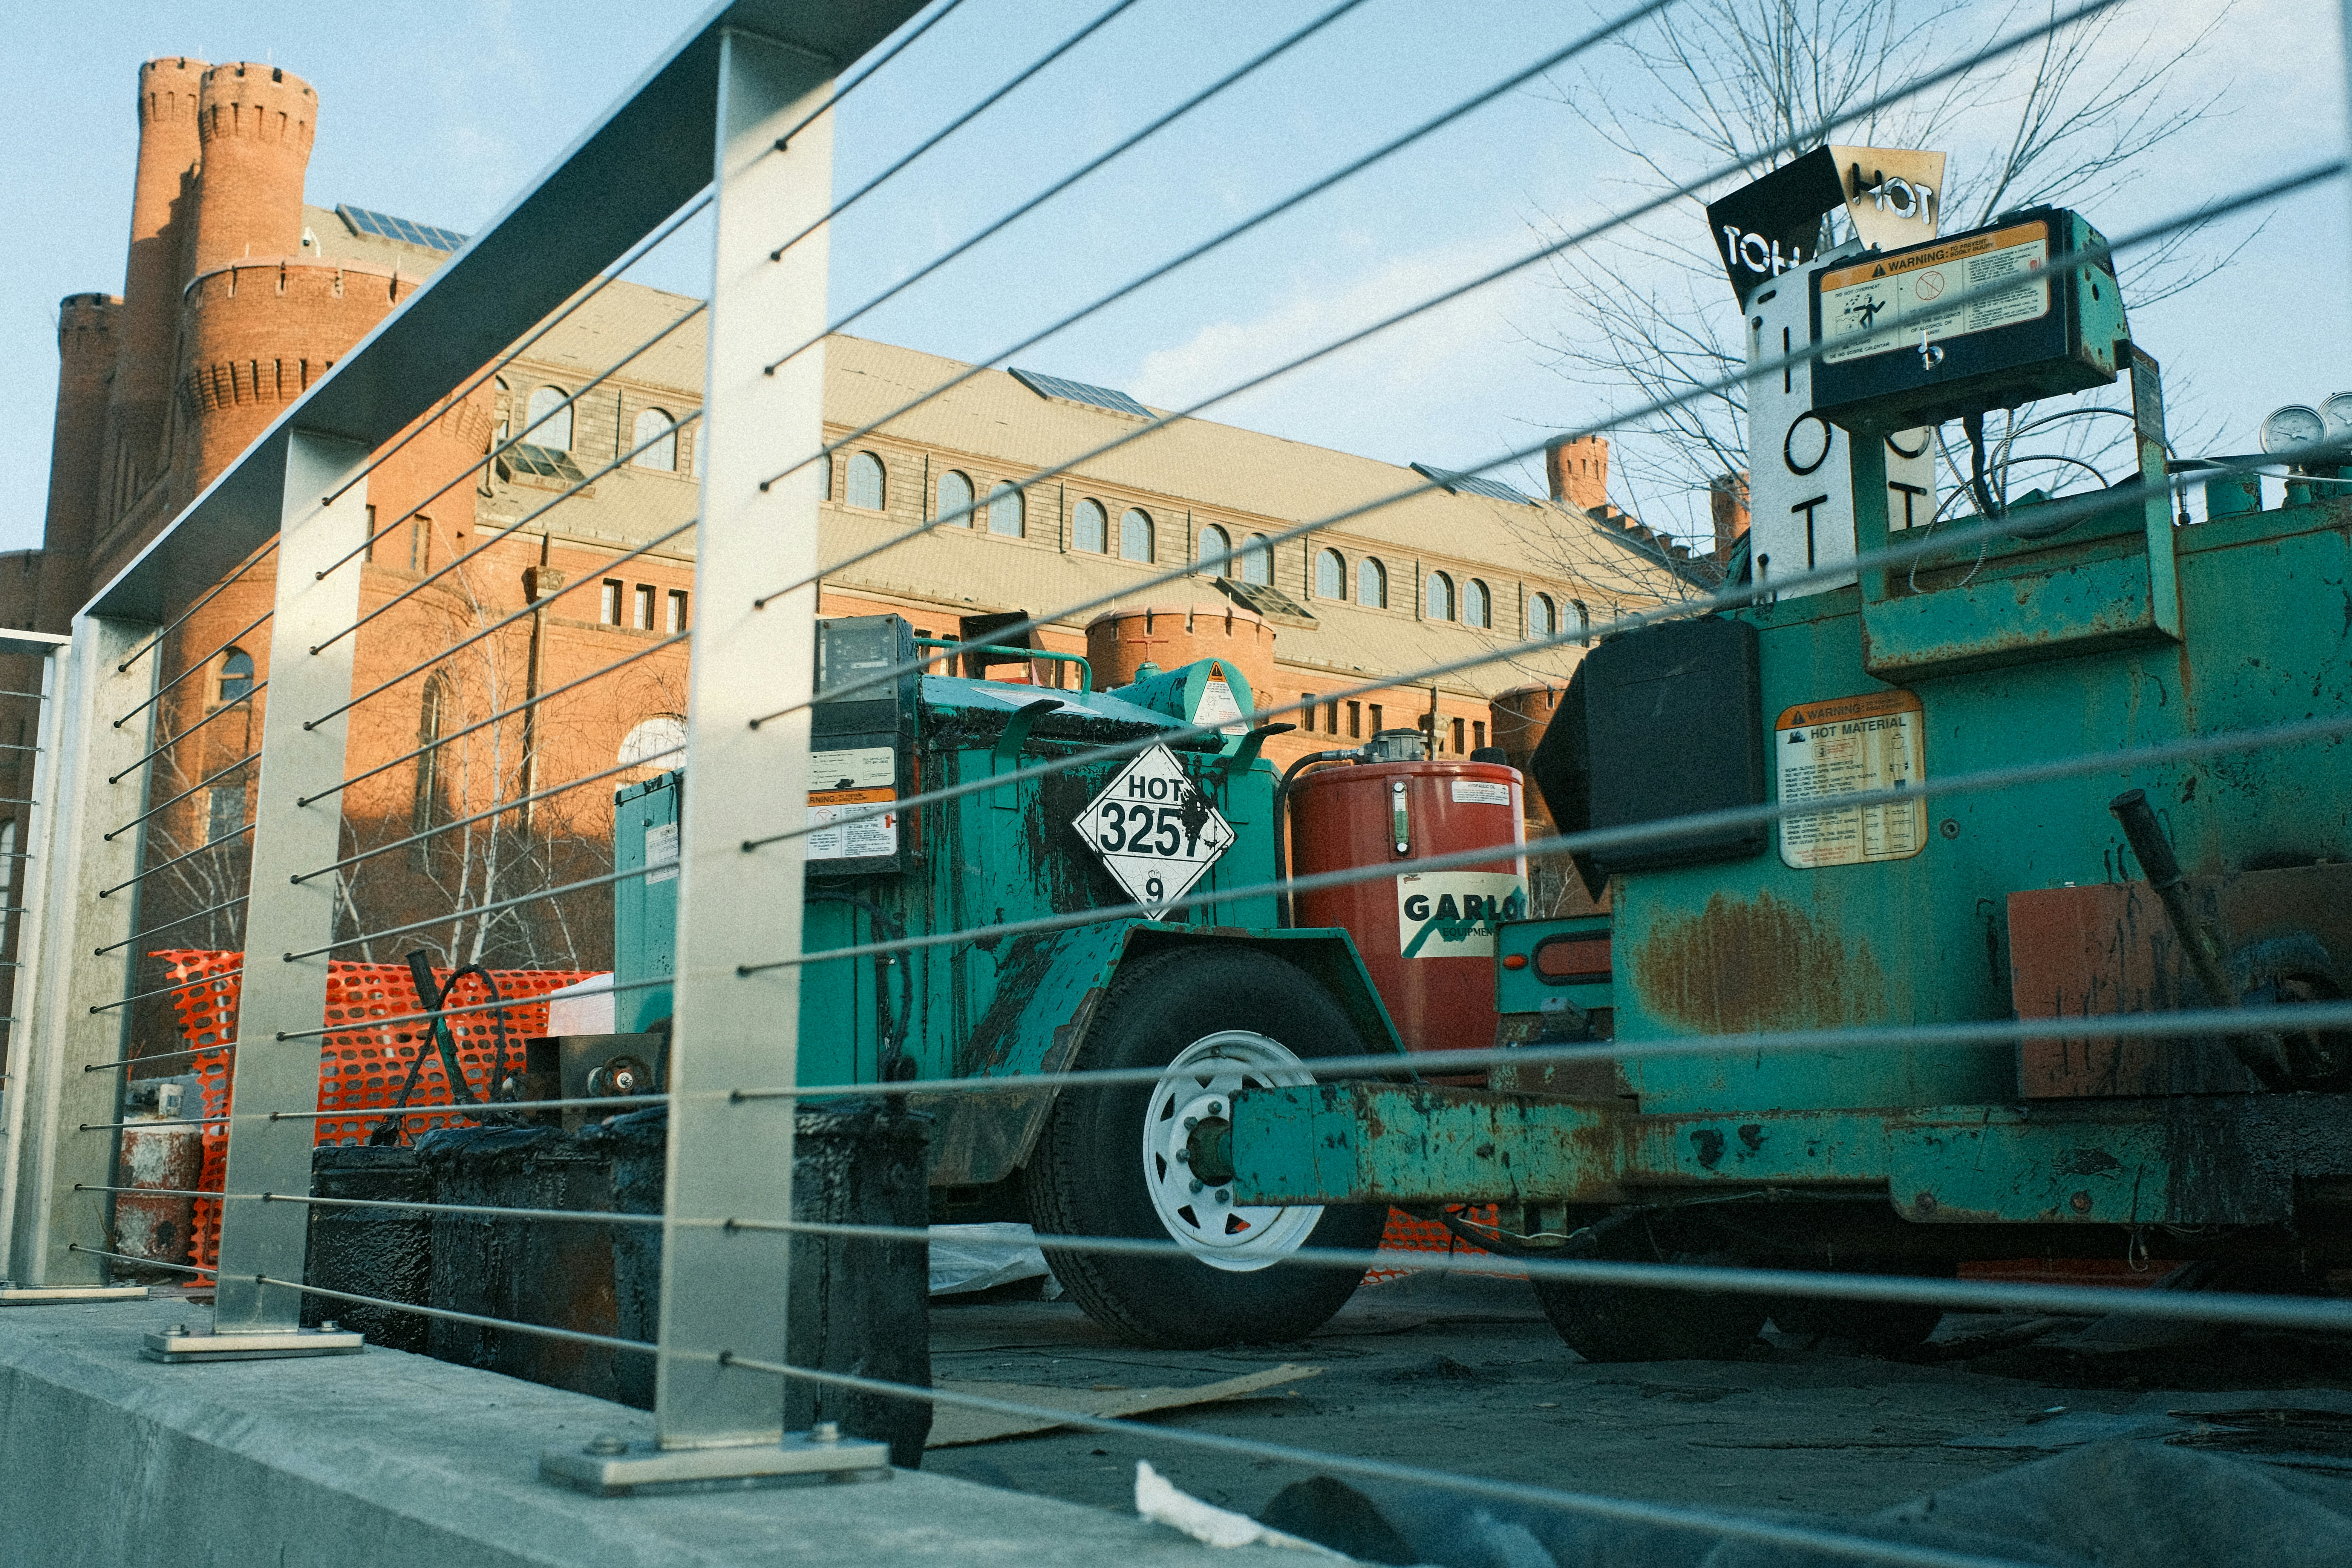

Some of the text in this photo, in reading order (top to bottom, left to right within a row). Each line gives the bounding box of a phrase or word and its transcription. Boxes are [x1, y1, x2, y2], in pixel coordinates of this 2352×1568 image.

[1852, 162, 1932, 225] HOT
[1950, 242, 1994, 257] BODILY INJURY
[1960, 239, 1987, 249] PREVENT
[1888, 250, 1948, 271] WARNING:
[1855, 283, 1880, 294] OVERHEAT
[1919, 322, 1943, 331] ALCOHOL
[1808, 704, 1865, 719] WARNING:
[1811, 717, 1906, 739] HOT MATERIAL
[1129, 775, 1184, 801] HOT
[808, 795, 838, 804] RNING:
[1145, 877, 1164, 905] 9
[1443, 928, 1493, 936] EQUIPMEN
